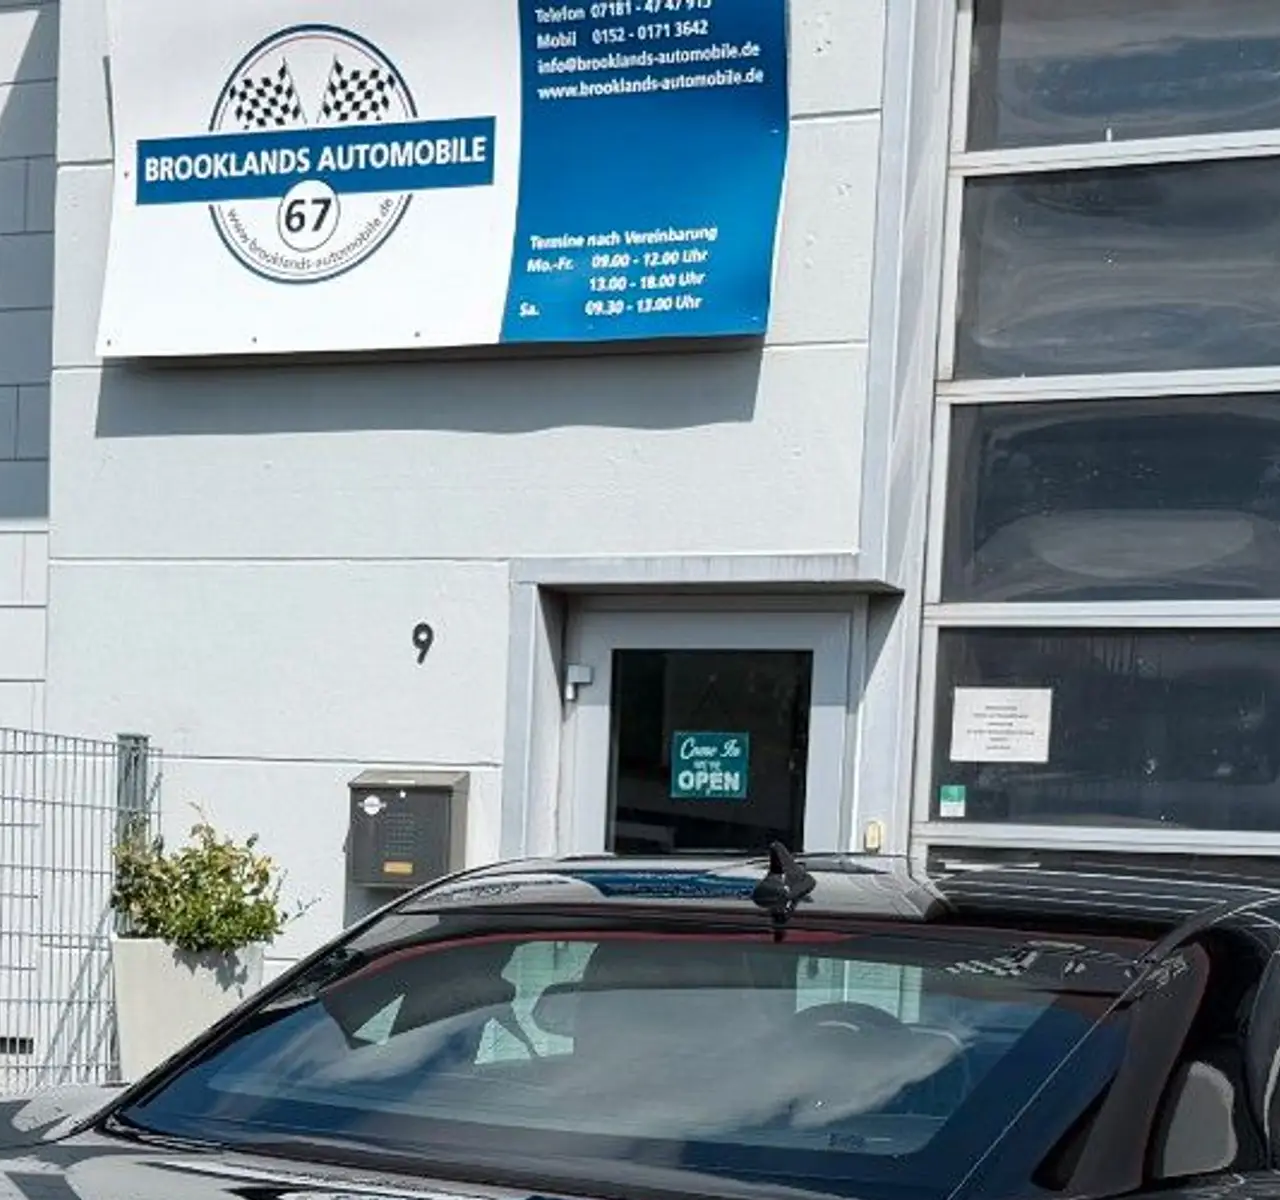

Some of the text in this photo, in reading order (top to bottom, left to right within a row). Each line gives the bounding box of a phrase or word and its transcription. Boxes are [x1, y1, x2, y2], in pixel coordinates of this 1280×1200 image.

[535, 7, 585, 23] Telefon
[590, 1, 632, 18] 07181
[536, 32, 577, 49] Mobil
[592, 26, 624, 44] 0152
[638, 22, 670, 40] 0171
[674, 19, 709, 38] 3642
[537, 41, 761, 74] info@brooklands-automobile.de
[537, 67, 765, 100] www.brooklands-automobile.de
[144, 136, 487, 183] BROOKLANDS AUTOMOBILE
[284, 198, 332, 232] 67
[530, 226, 718, 250] Termine nach Vereinbarung
[591, 253, 630, 269] 09.00
[643, 251, 679, 267] 12.00
[682, 248, 708, 263] Uhr
[589, 276, 627, 291] 13.00
[640, 273, 676, 289] 18.00
[678, 271, 706, 286] Uhr
[519, 302, 539, 317] Sa.
[675, 295, 703, 310] Uhr
[412, 622, 434, 664] 9
[678, 770, 740, 791] OPEN
